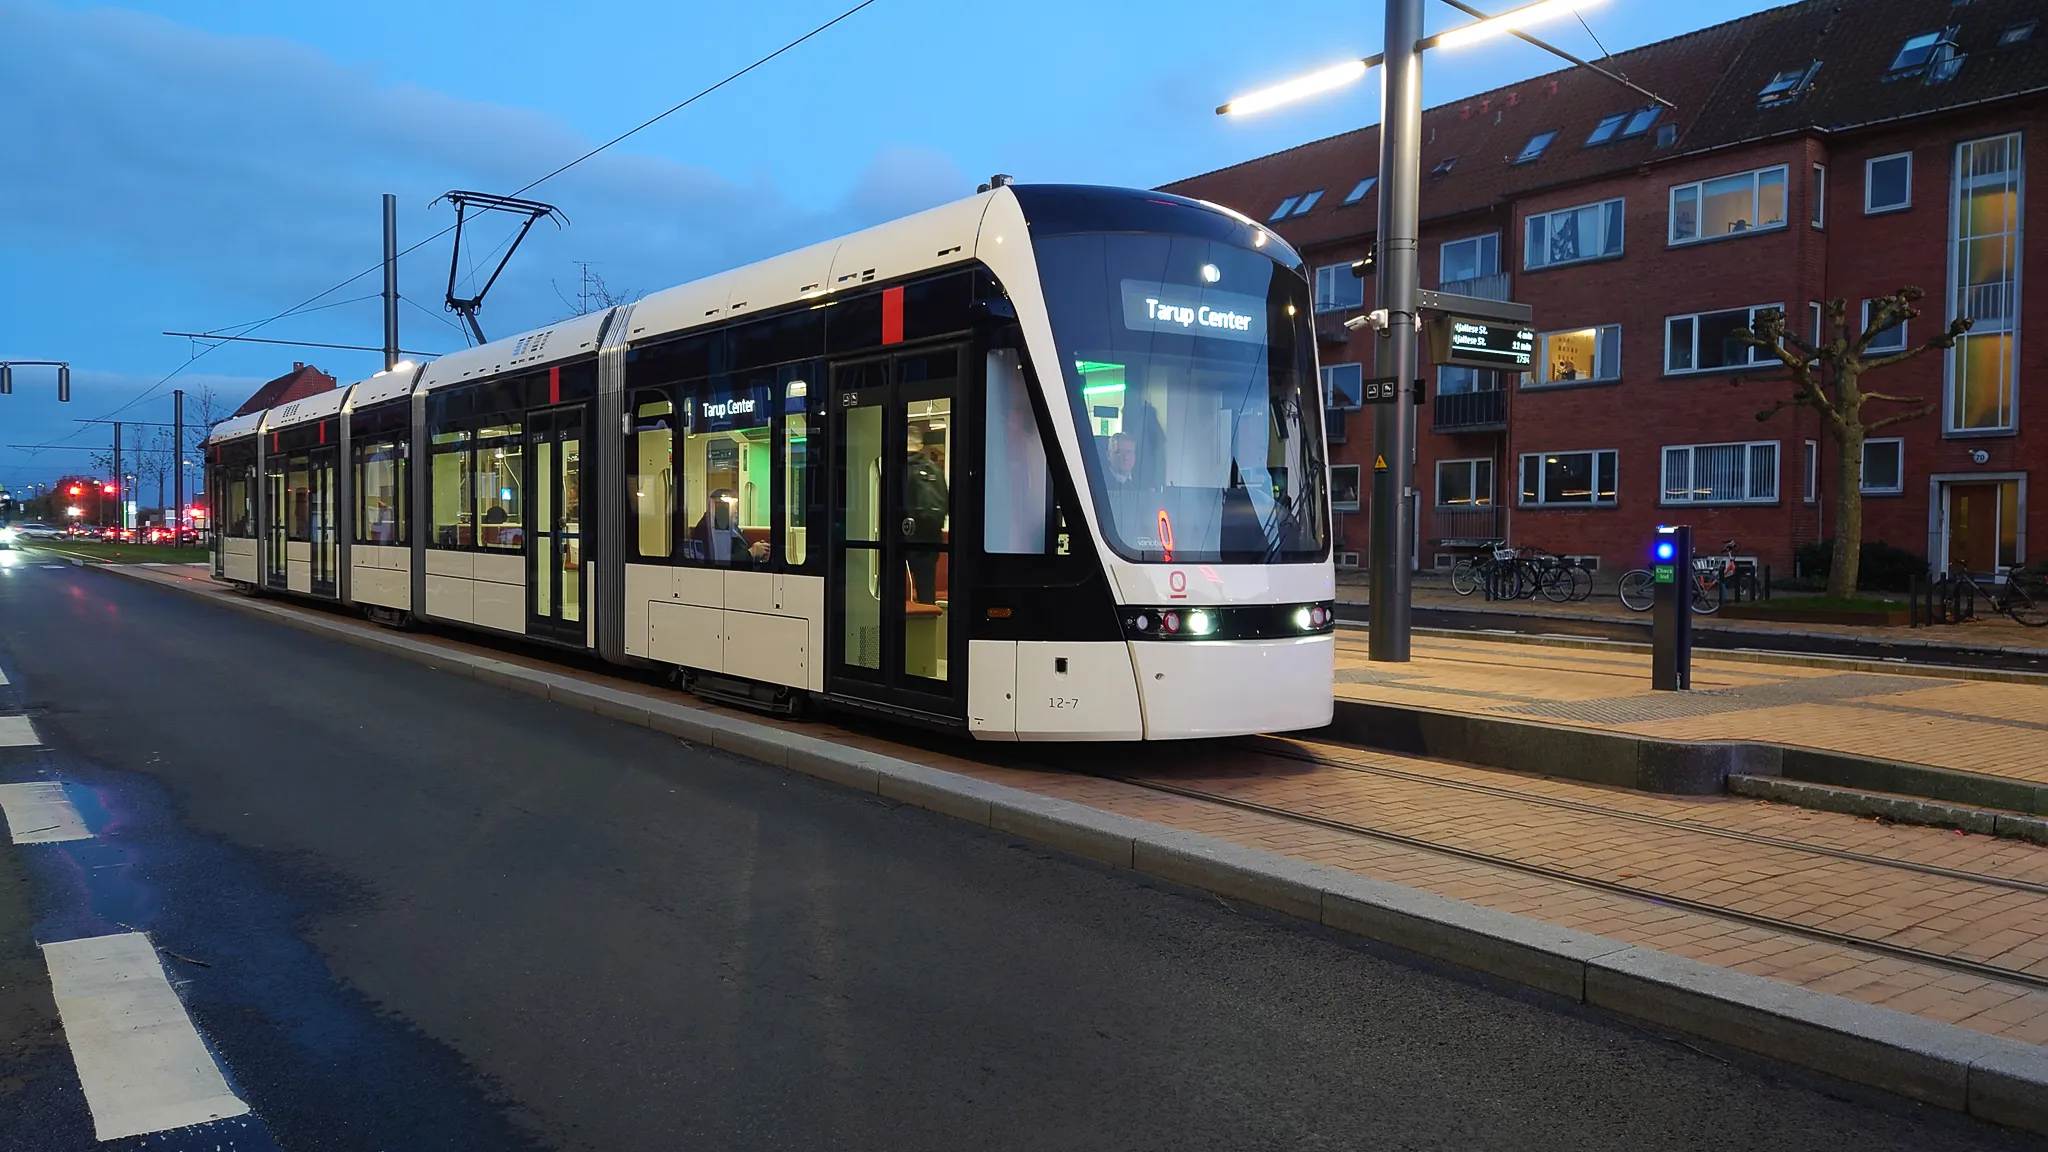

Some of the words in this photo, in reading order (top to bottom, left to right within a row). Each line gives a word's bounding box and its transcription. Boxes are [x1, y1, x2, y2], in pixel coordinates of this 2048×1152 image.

[1146, 298, 1194, 327] Tarup
[1198, 306, 1252, 331] Center
[1522, 331, 1533, 340] min
[1521, 342, 1531, 351] min
[703, 402, 726, 419] Tarup
[727, 398, 755, 414] Center
[1049, 697, 1079, 709] 12-7
